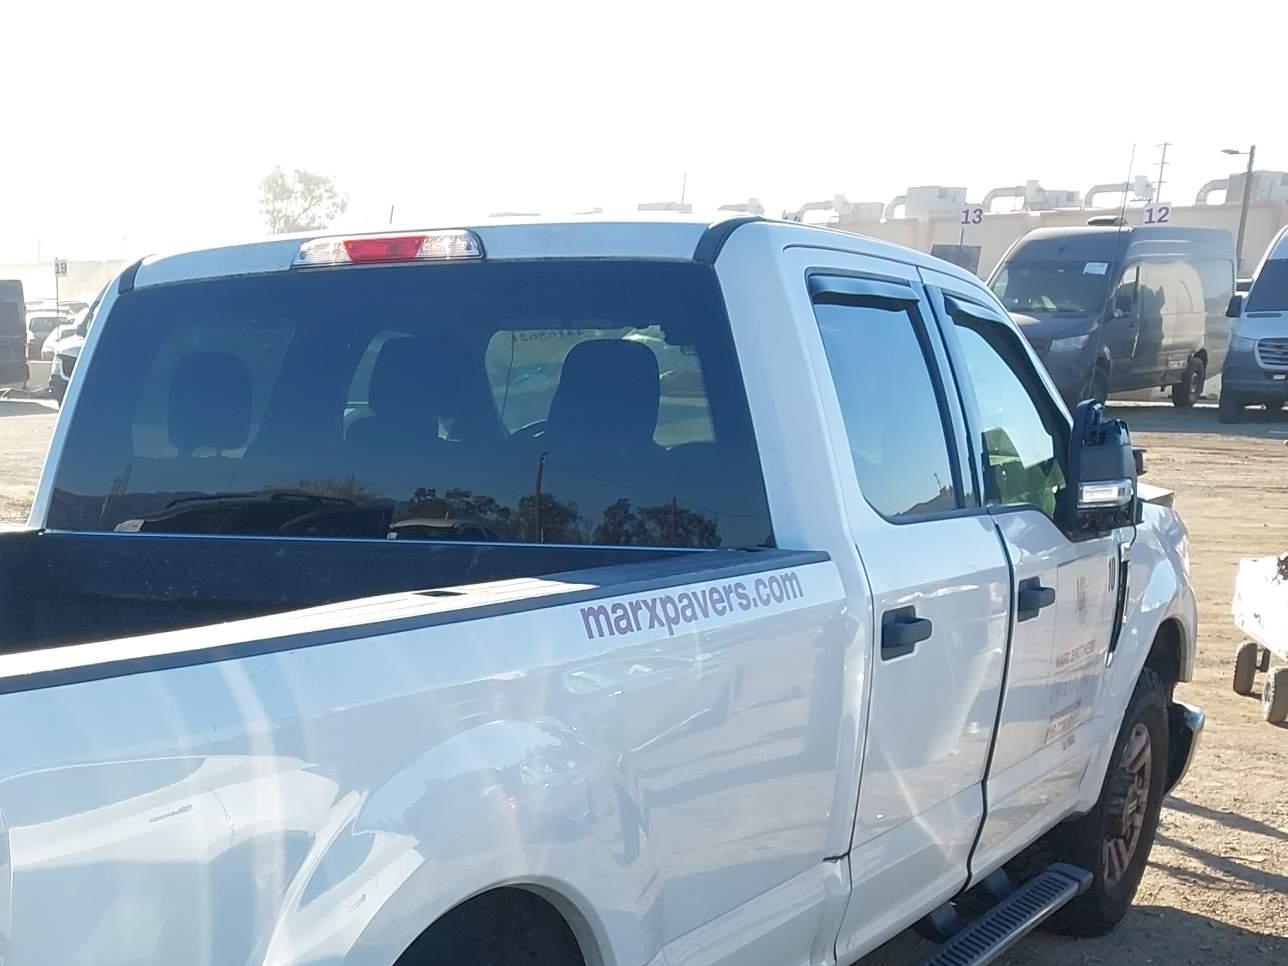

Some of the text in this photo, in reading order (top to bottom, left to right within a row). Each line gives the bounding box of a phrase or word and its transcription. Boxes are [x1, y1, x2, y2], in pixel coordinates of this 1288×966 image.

[961, 208, 983, 225] 13
[1144, 206, 1170, 224] 12
[55, 260, 67, 275] 19
[580, 571, 804, 640] marxpavers.com
